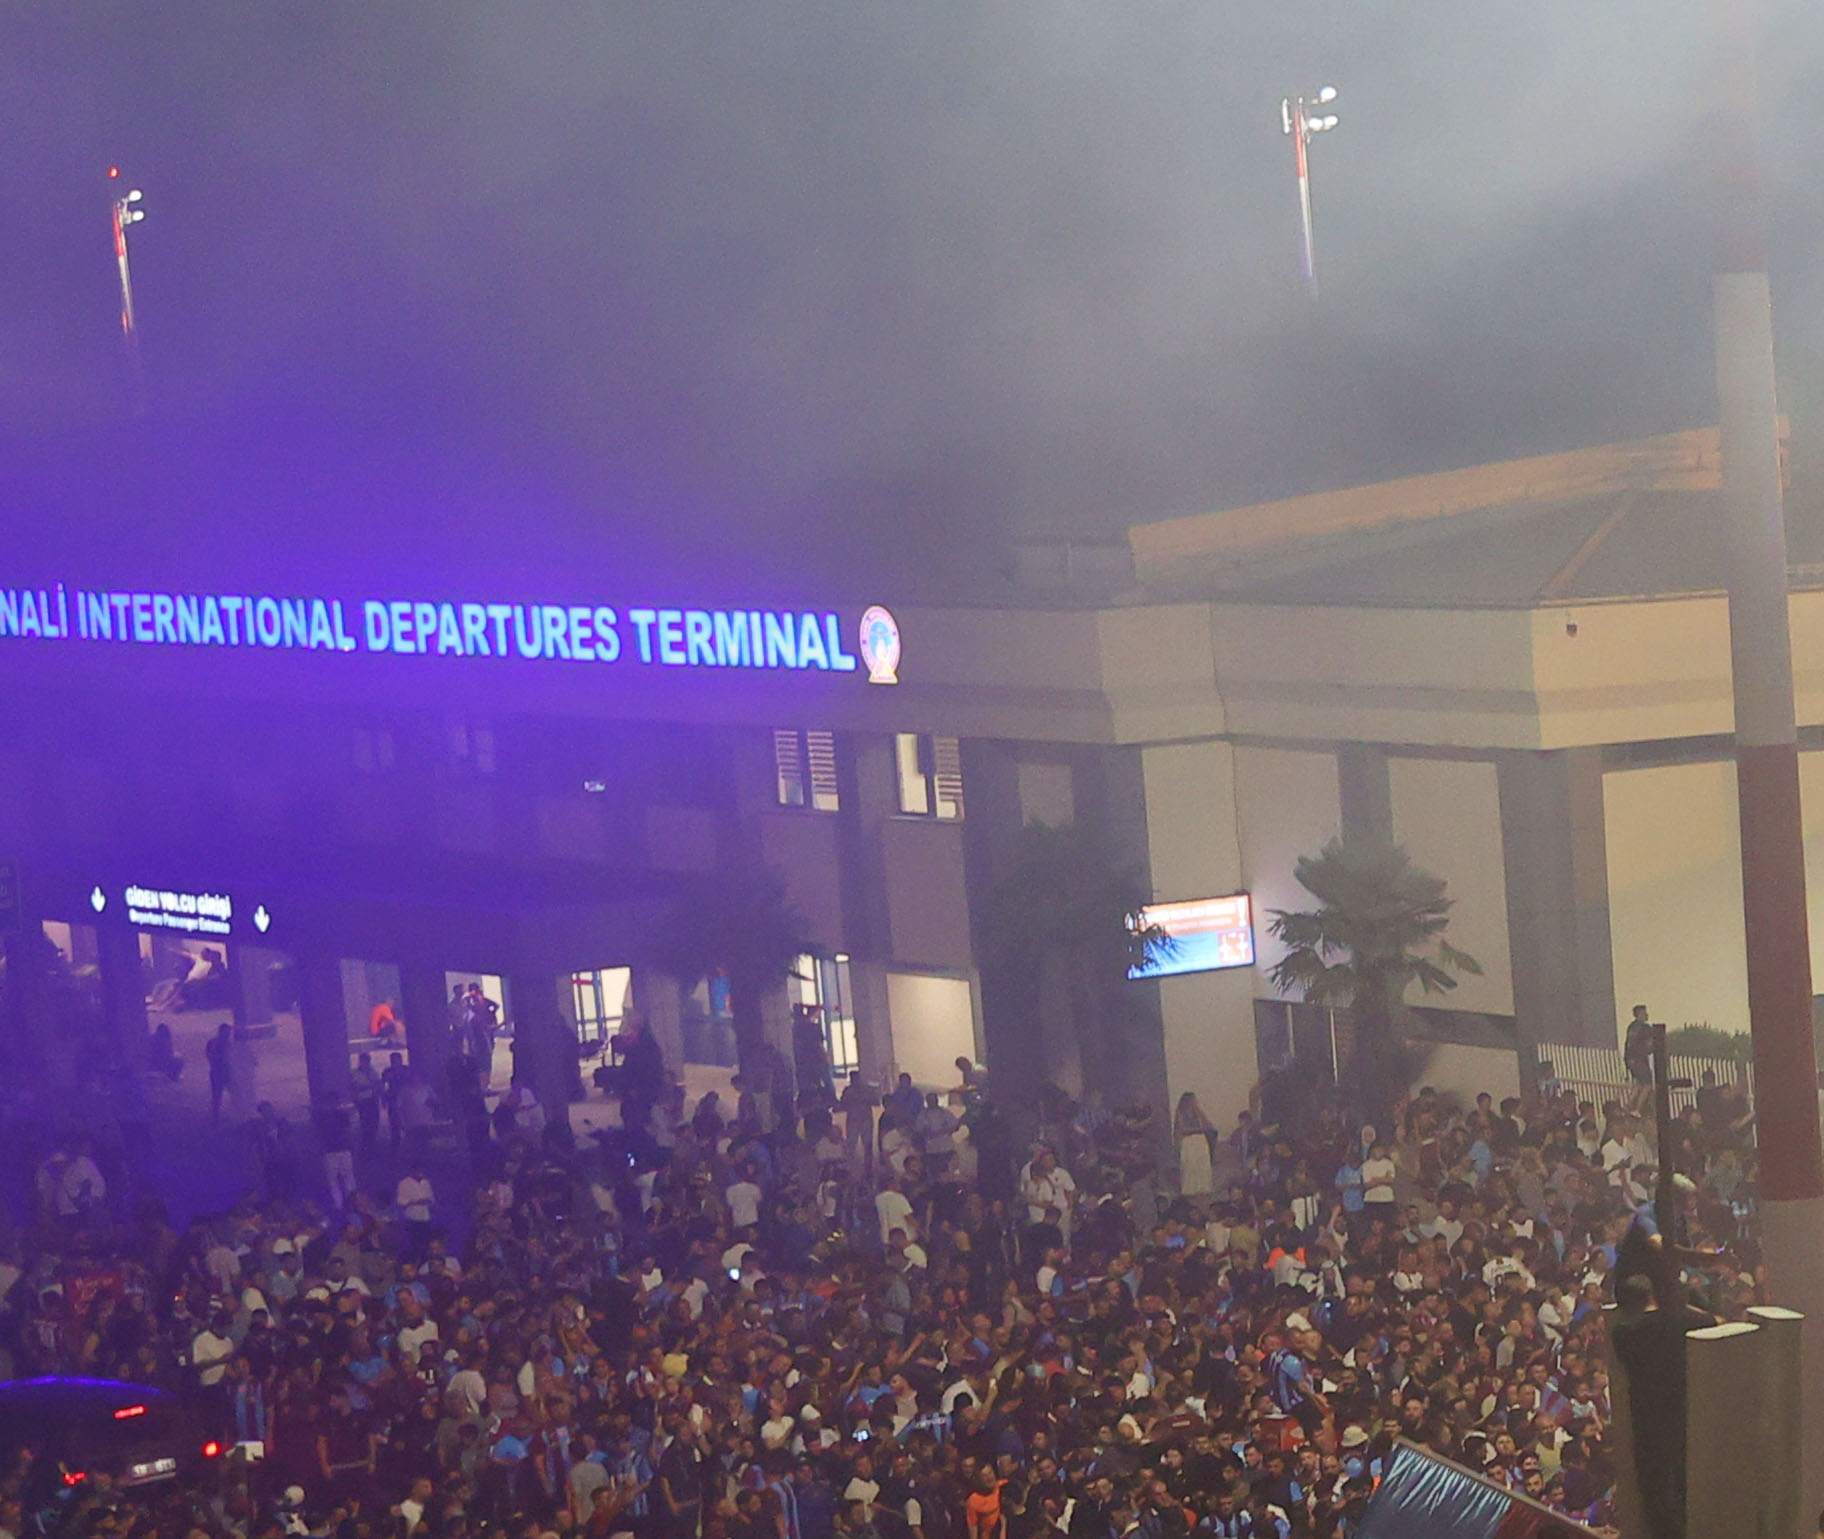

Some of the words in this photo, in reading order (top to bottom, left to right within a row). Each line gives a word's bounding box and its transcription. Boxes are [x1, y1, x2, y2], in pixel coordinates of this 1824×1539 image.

[0, 582, 68, 638] NALİ
[77, 590, 357, 651] INTERNATIONAL
[364, 600, 621, 662] DEPARTURES
[629, 609, 856, 672] TERMINAL
